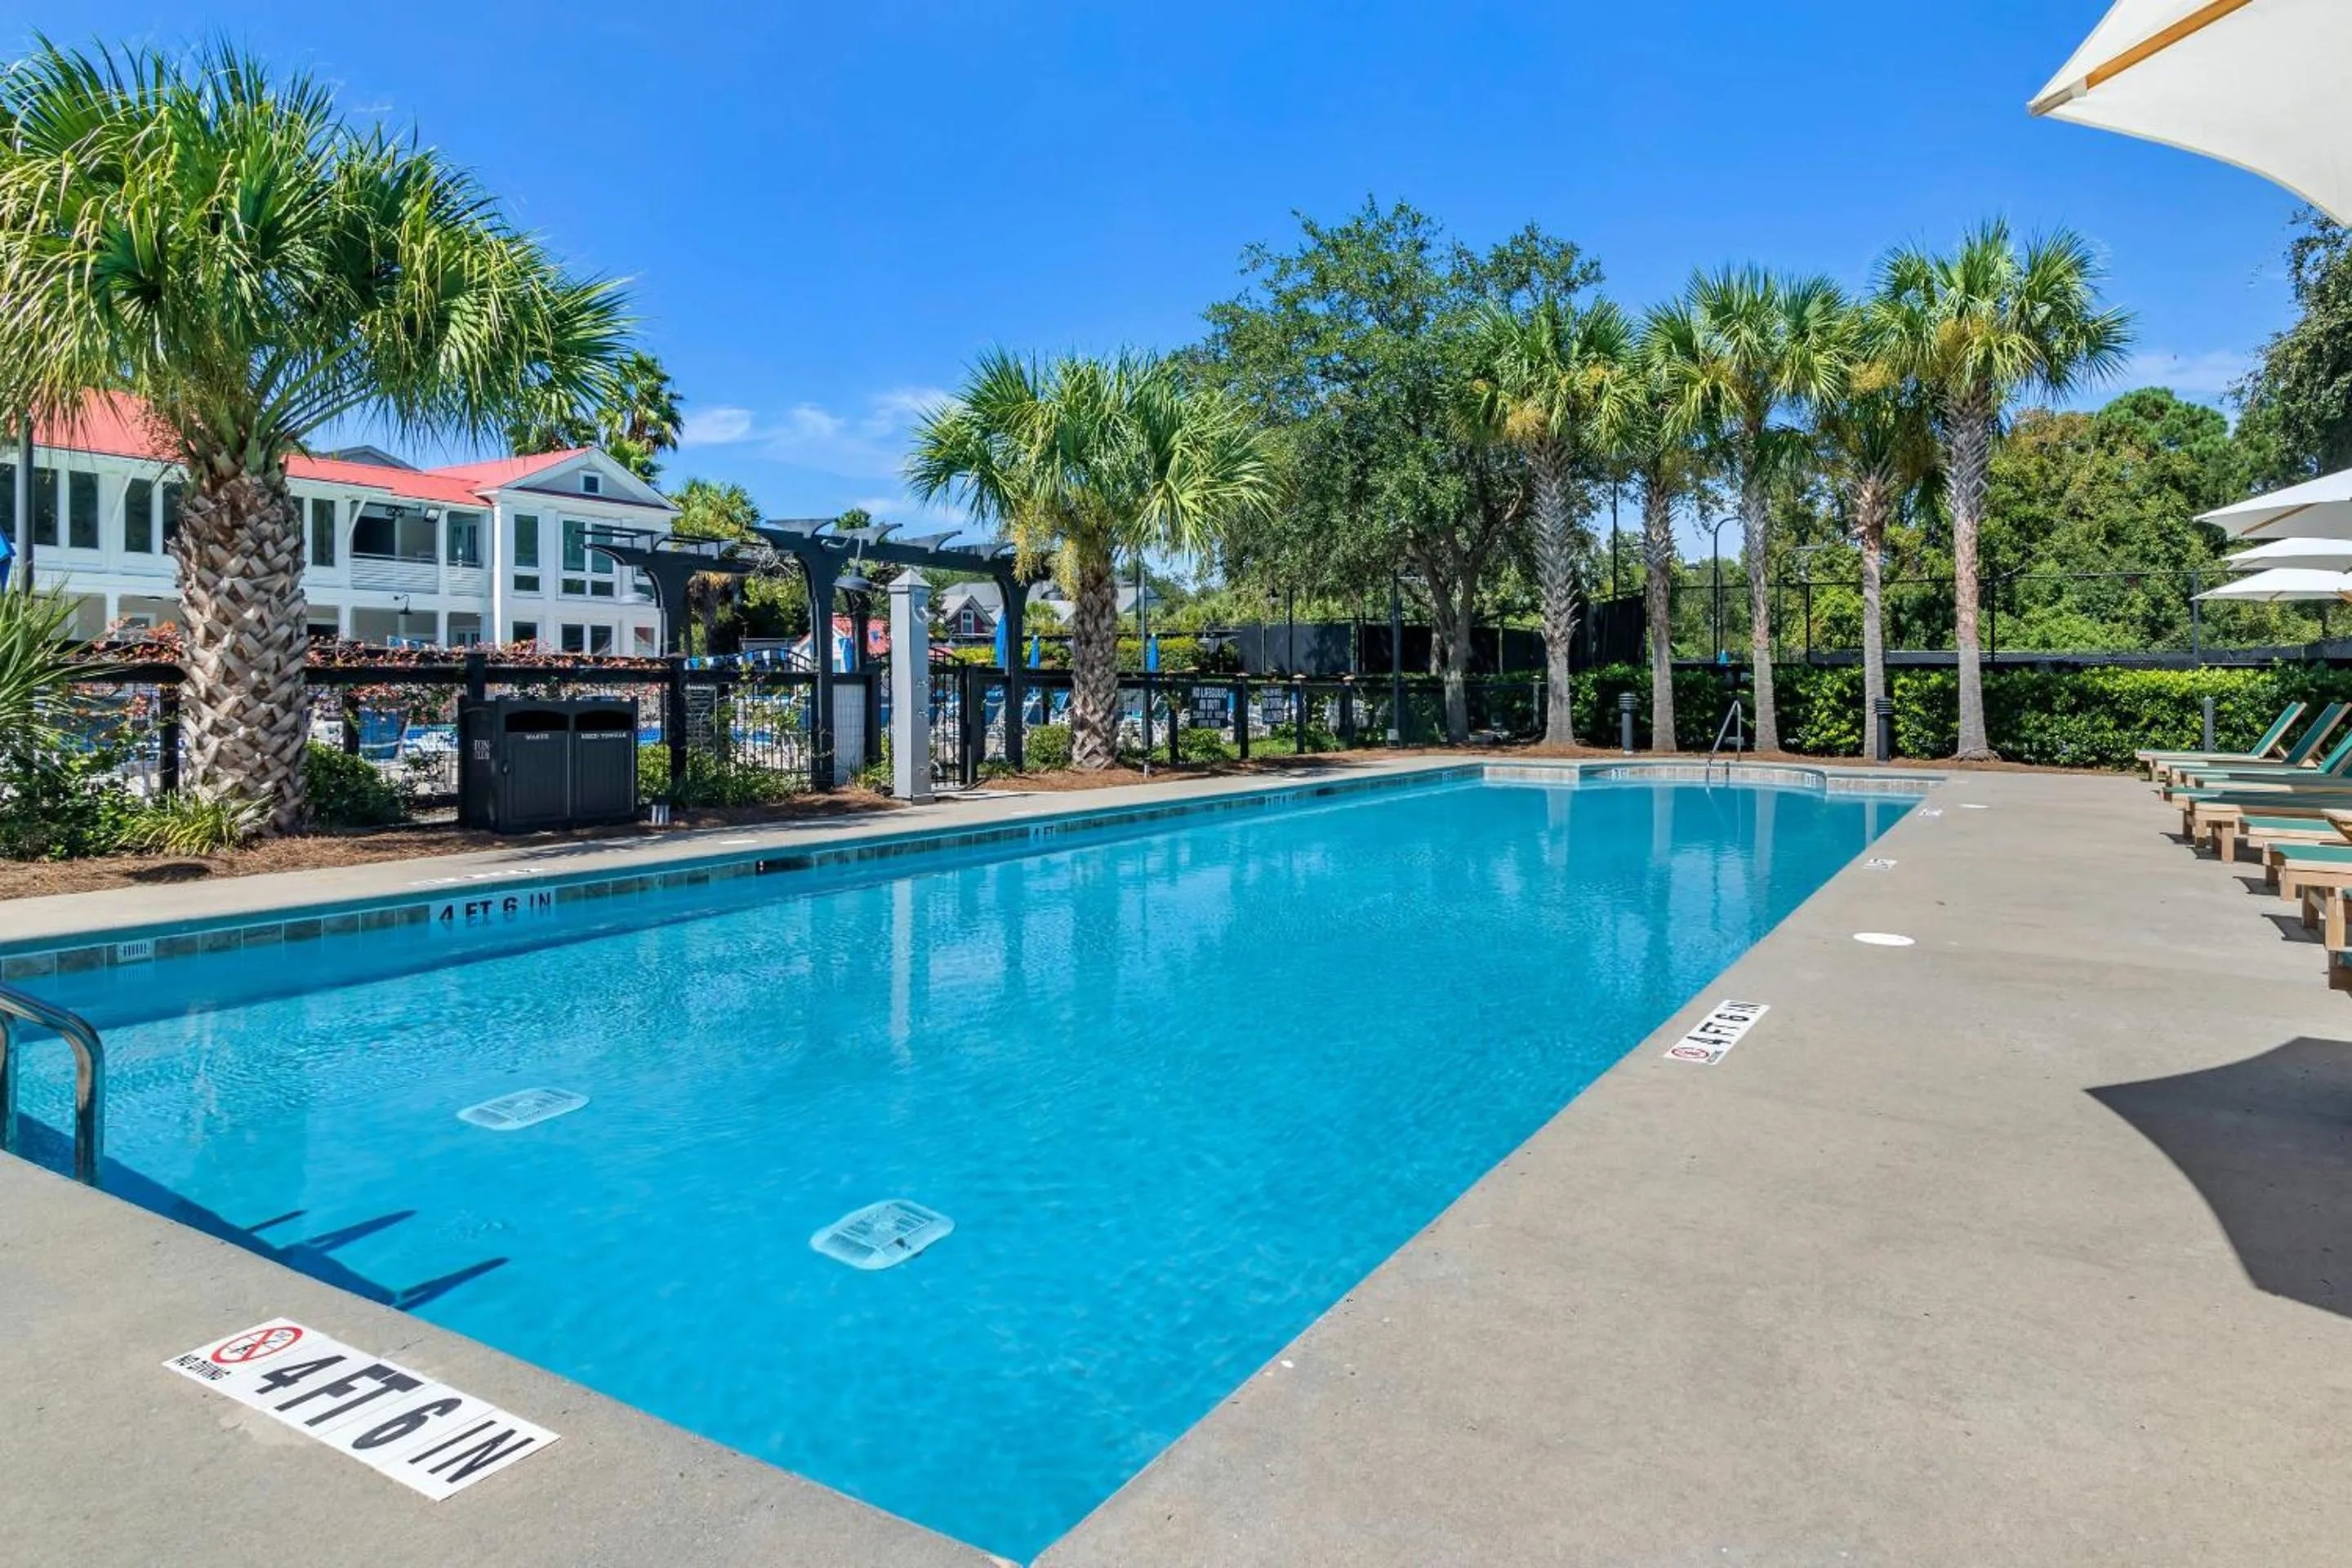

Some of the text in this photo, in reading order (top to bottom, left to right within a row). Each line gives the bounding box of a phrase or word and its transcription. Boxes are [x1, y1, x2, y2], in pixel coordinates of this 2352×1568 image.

[439, 905, 454, 920] 4
[503, 897, 519, 911] 6
[529, 892, 551, 908] IN
[1714, 1013, 1750, 1022] 6
[1699, 1022, 1741, 1037] FT
[1686, 1036, 1732, 1045] 4
[254, 1355, 536, 1484] 4 FT 6 IN
